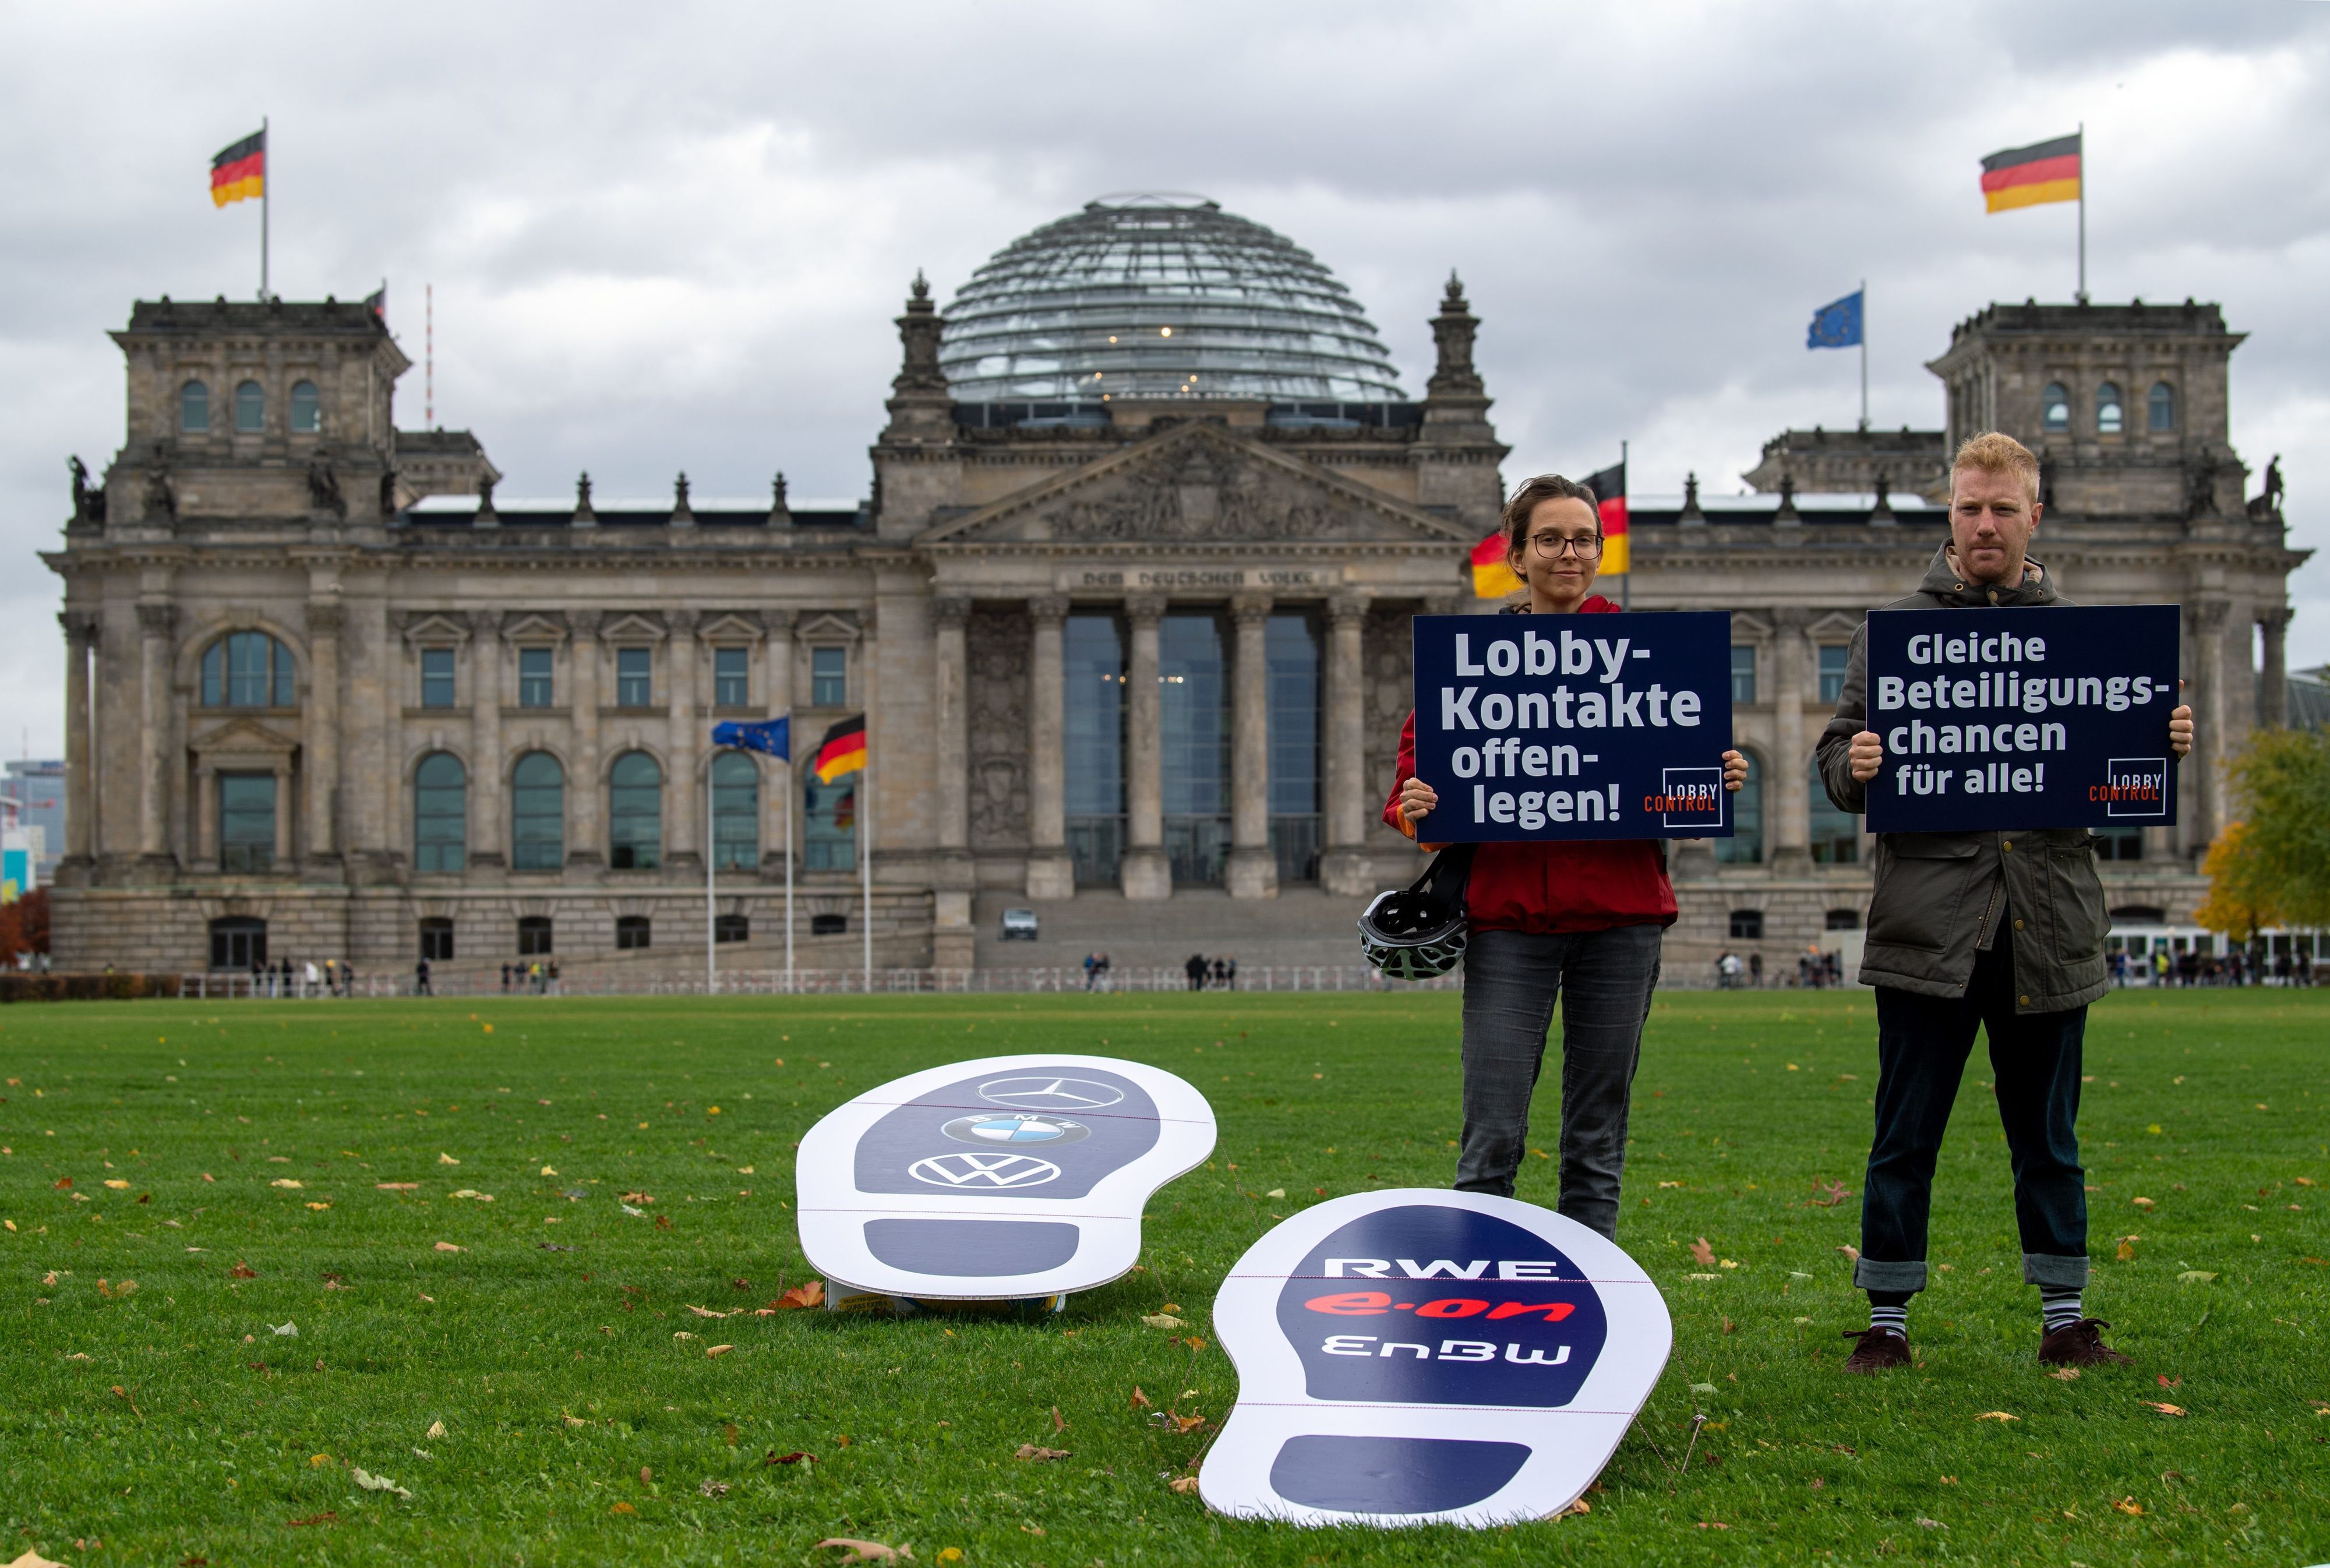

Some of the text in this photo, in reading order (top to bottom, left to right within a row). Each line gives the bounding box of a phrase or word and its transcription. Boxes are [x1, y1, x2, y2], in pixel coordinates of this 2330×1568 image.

[1456, 630, 1650, 684] Lobby-
[1908, 632, 2046, 665] Gleiche
[1442, 683, 1701, 730] Kontakte
[1879, 671, 2169, 713] Beteiligungs-
[1888, 719, 2066, 755] chancen
[1452, 737, 1598, 778] offen-
[1668, 784, 1718, 801] LOBBY
[1896, 763, 2044, 796] für alle!
[2089, 785, 2159, 801] CONTROL
[2113, 774, 2162, 790] LOBBY
[1474, 784, 1620, 830] legen!
[1644, 795, 1715, 813] CONTROL
[965, 1114, 1081, 1129] BMW
[1324, 1258, 1559, 1281] RWE
[1321, 1335, 1572, 1365] EnBW
